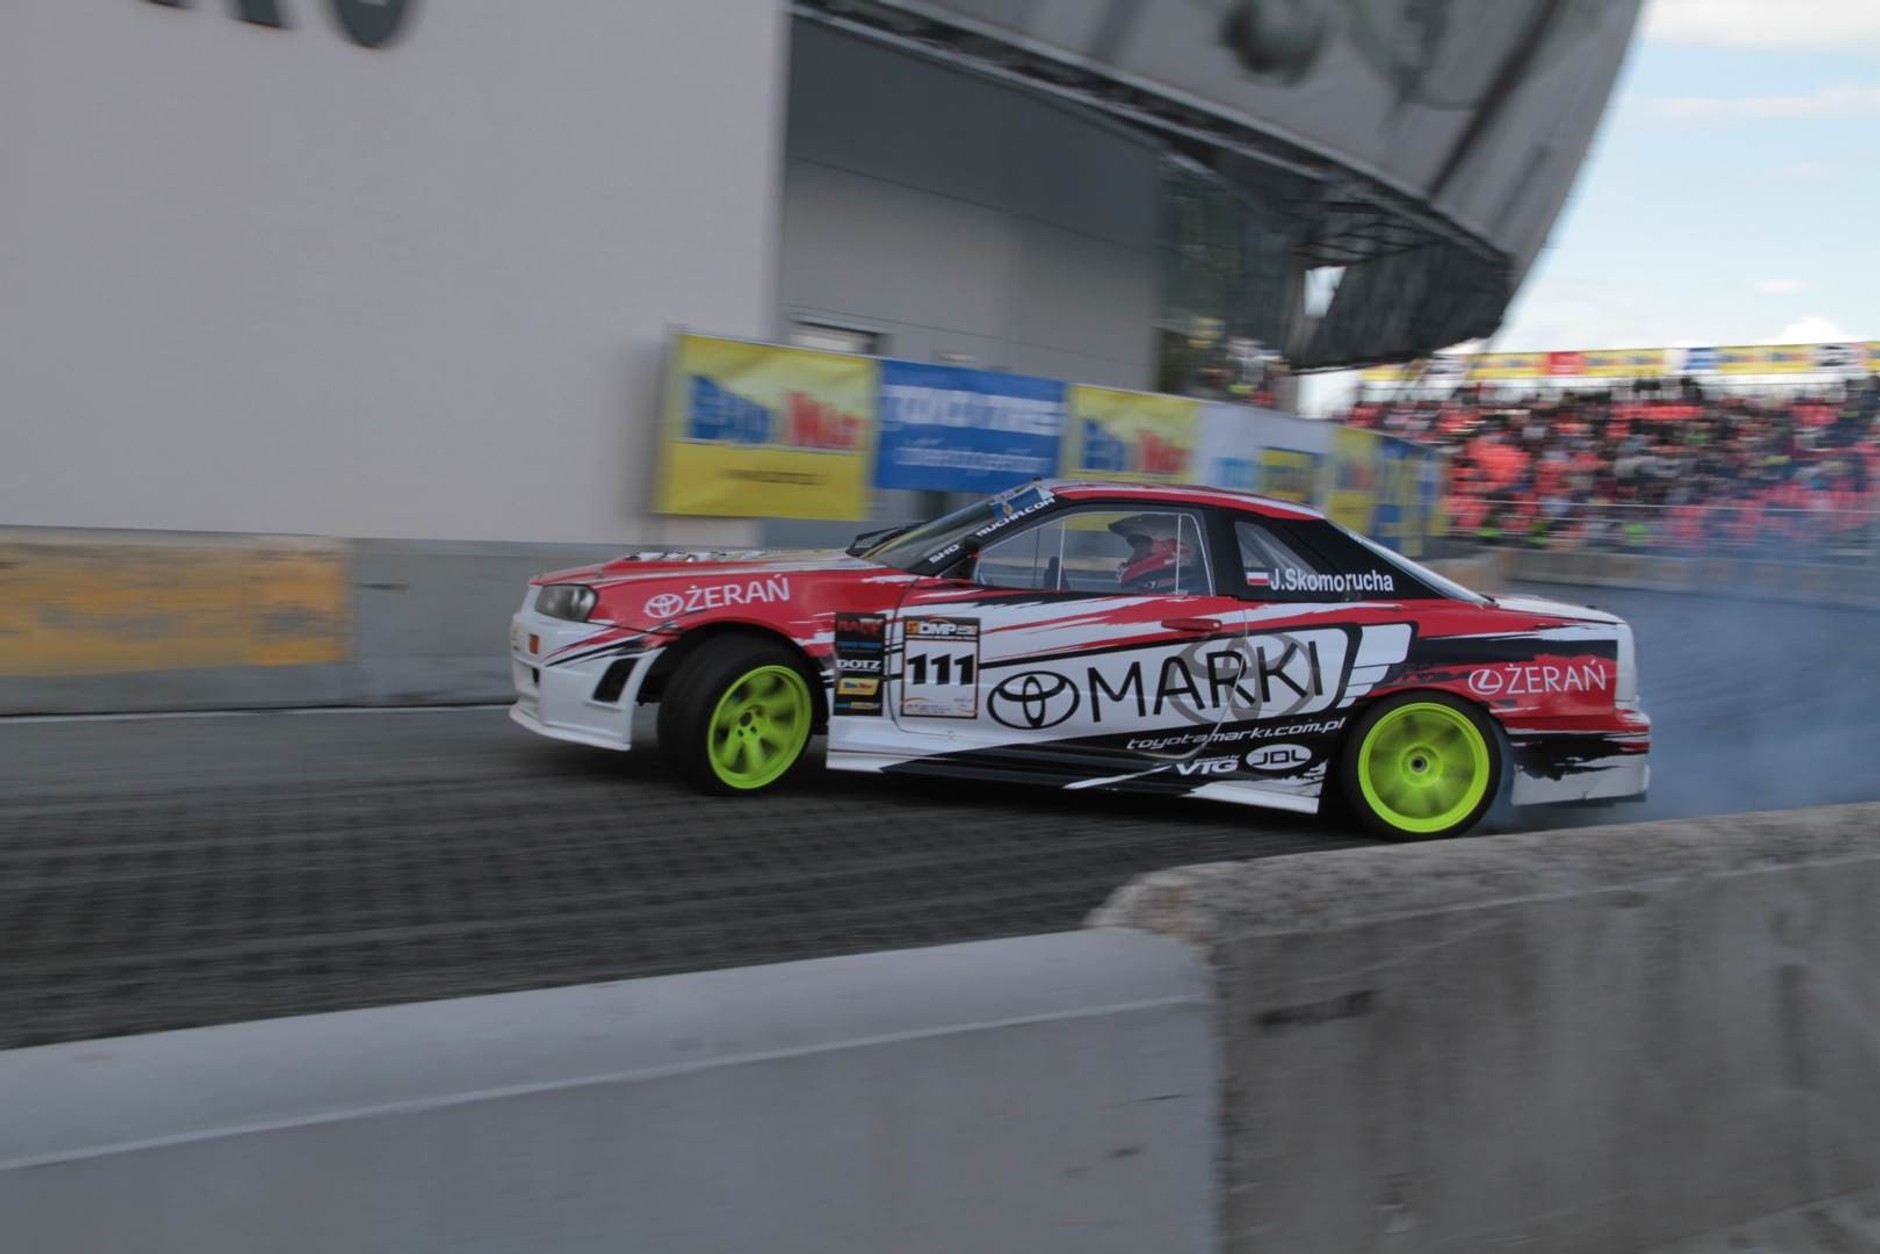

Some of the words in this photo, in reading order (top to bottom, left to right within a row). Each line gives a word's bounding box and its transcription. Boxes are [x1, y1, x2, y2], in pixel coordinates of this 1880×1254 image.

[684, 573, 791, 612] ŻERAŃ
[1270, 568, 1394, 591] J.Skomorucha
[836, 659, 881, 669] DOTZ
[907, 653, 975, 685] 111
[1505, 659, 1607, 694] ŻERAŃ
[1087, 641, 1324, 723] MARKI
[1126, 717, 1347, 750] toyotamarki.com.pl
[1176, 760, 1239, 776] VTG
[1252, 749, 1307, 766] JDL
